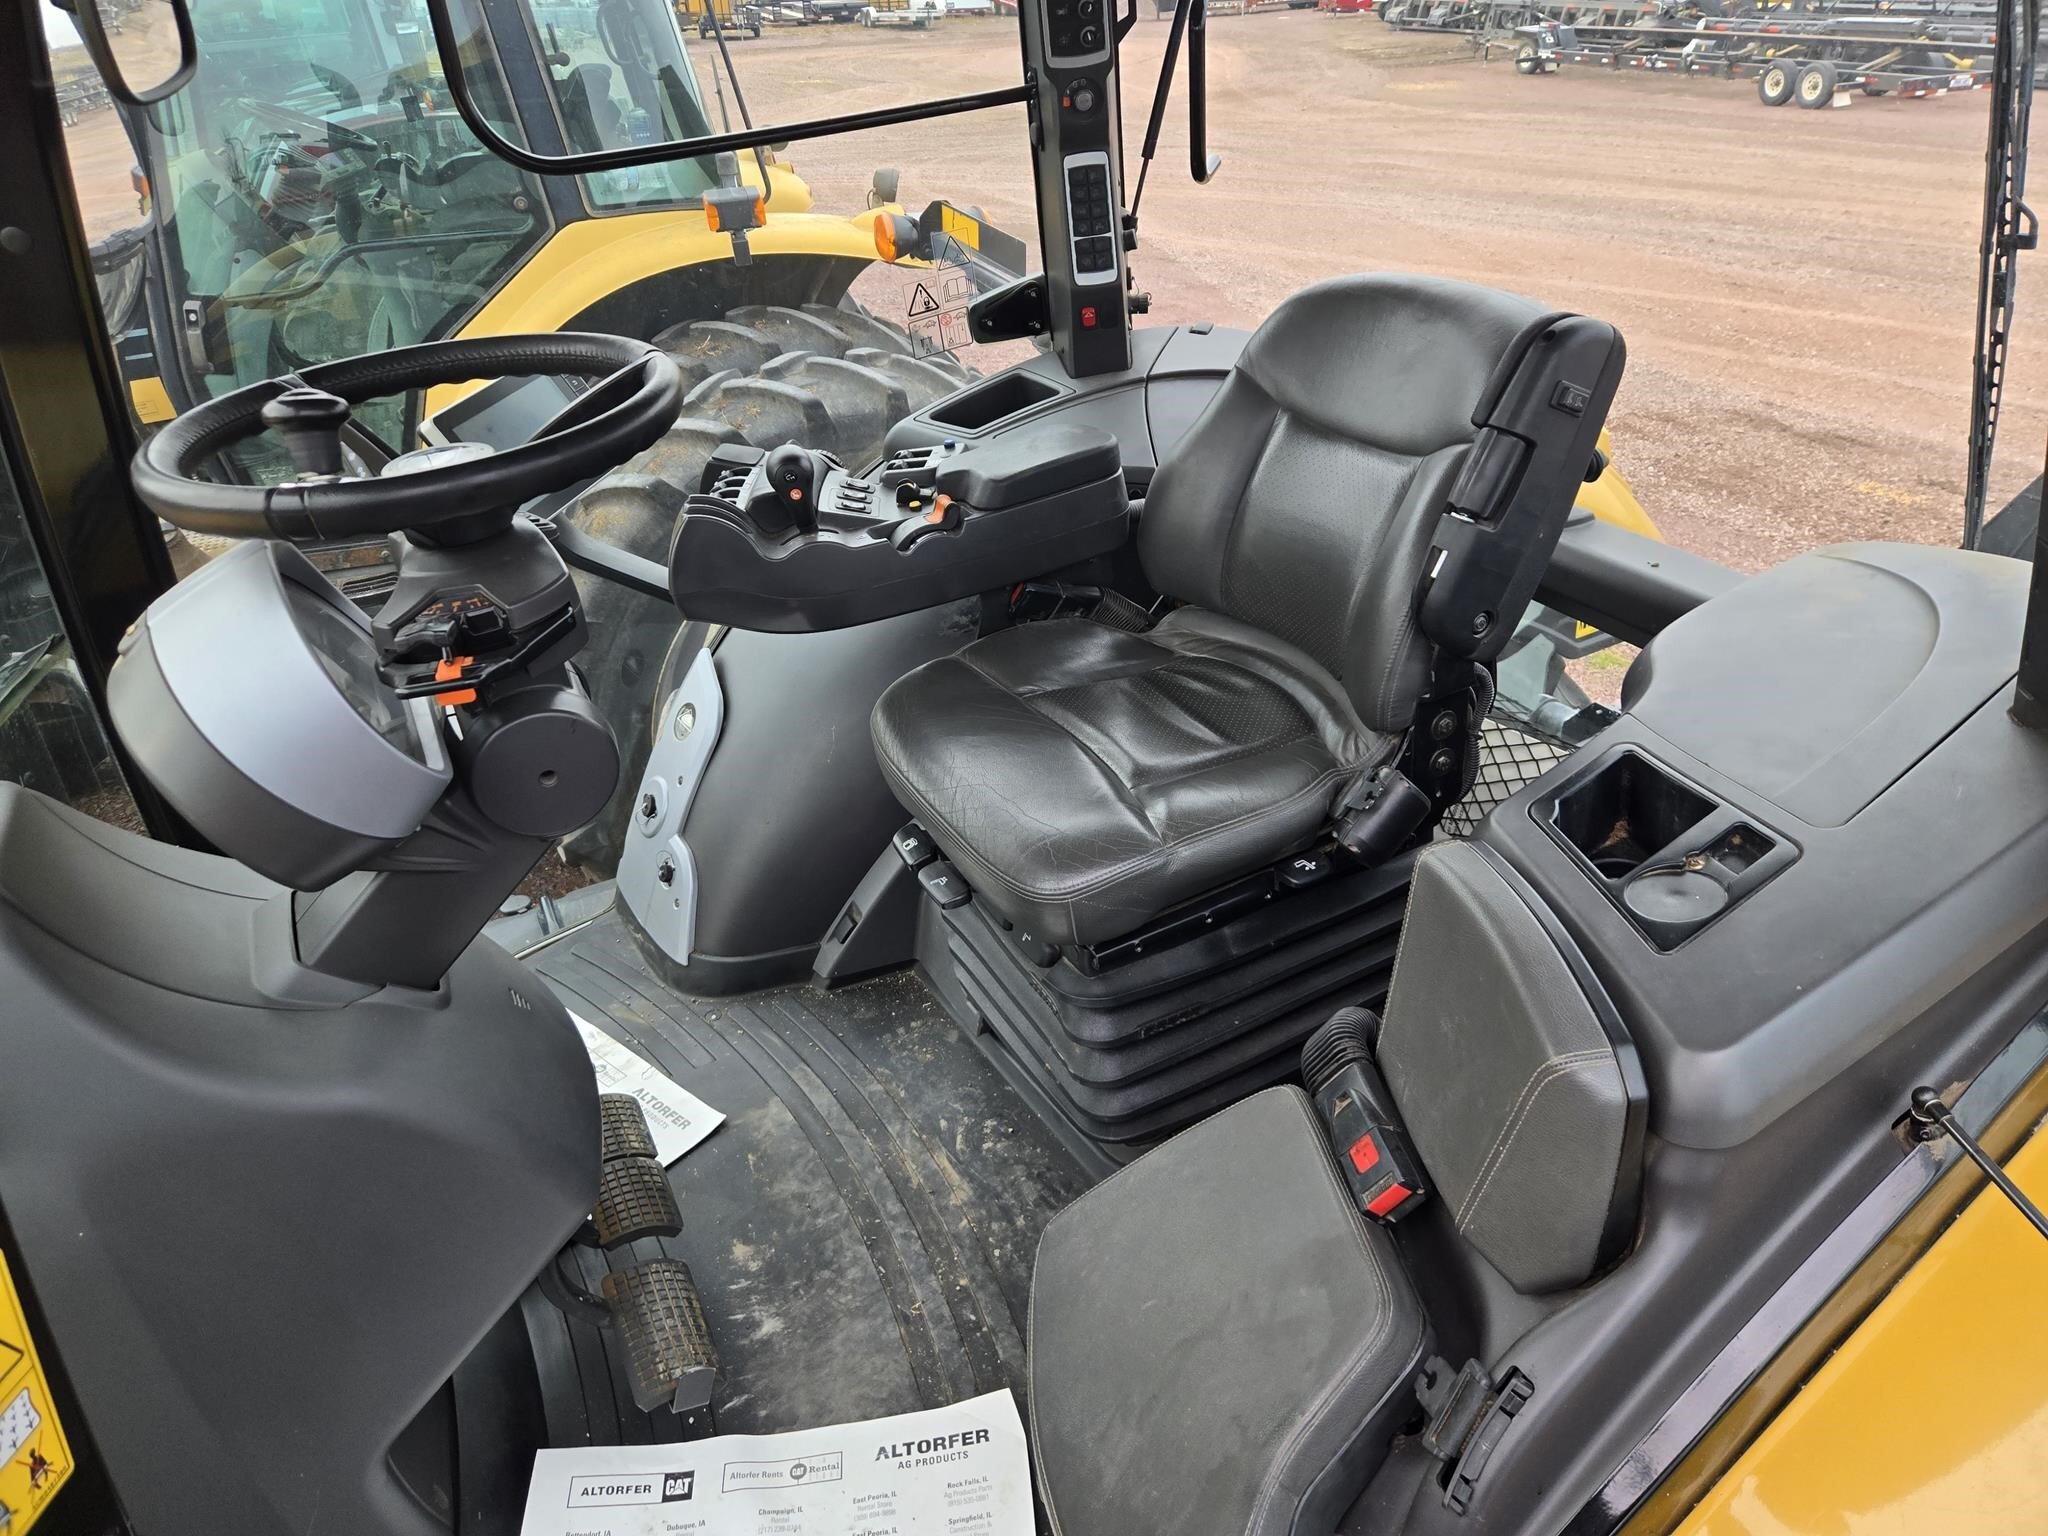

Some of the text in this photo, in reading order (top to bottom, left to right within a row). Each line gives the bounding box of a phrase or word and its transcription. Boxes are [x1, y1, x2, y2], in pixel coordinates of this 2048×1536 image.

[632, 1088, 691, 1130] ALTORFER
[875, 1429, 990, 1461] ALTORFER
[898, 1451, 969, 1469] AG PRODUCTS
[730, 1471, 760, 1480] Altorfer
[762, 1470, 784, 1479] Rents
[808, 1462, 840, 1473] Rental
[581, 1477, 693, 1496] ALTORFER CAT
[947, 1481, 963, 1489] Rock
[853, 1496, 866, 1504] East
[867, 1492, 890, 1501] Peoria,
[758, 1507, 795, 1516] Champaign,
[666, 1519, 706, 1531] Dubuque, IA
[948, 1513, 985, 1525] Springfield,
[892, 1526, 898, 1534] IL
